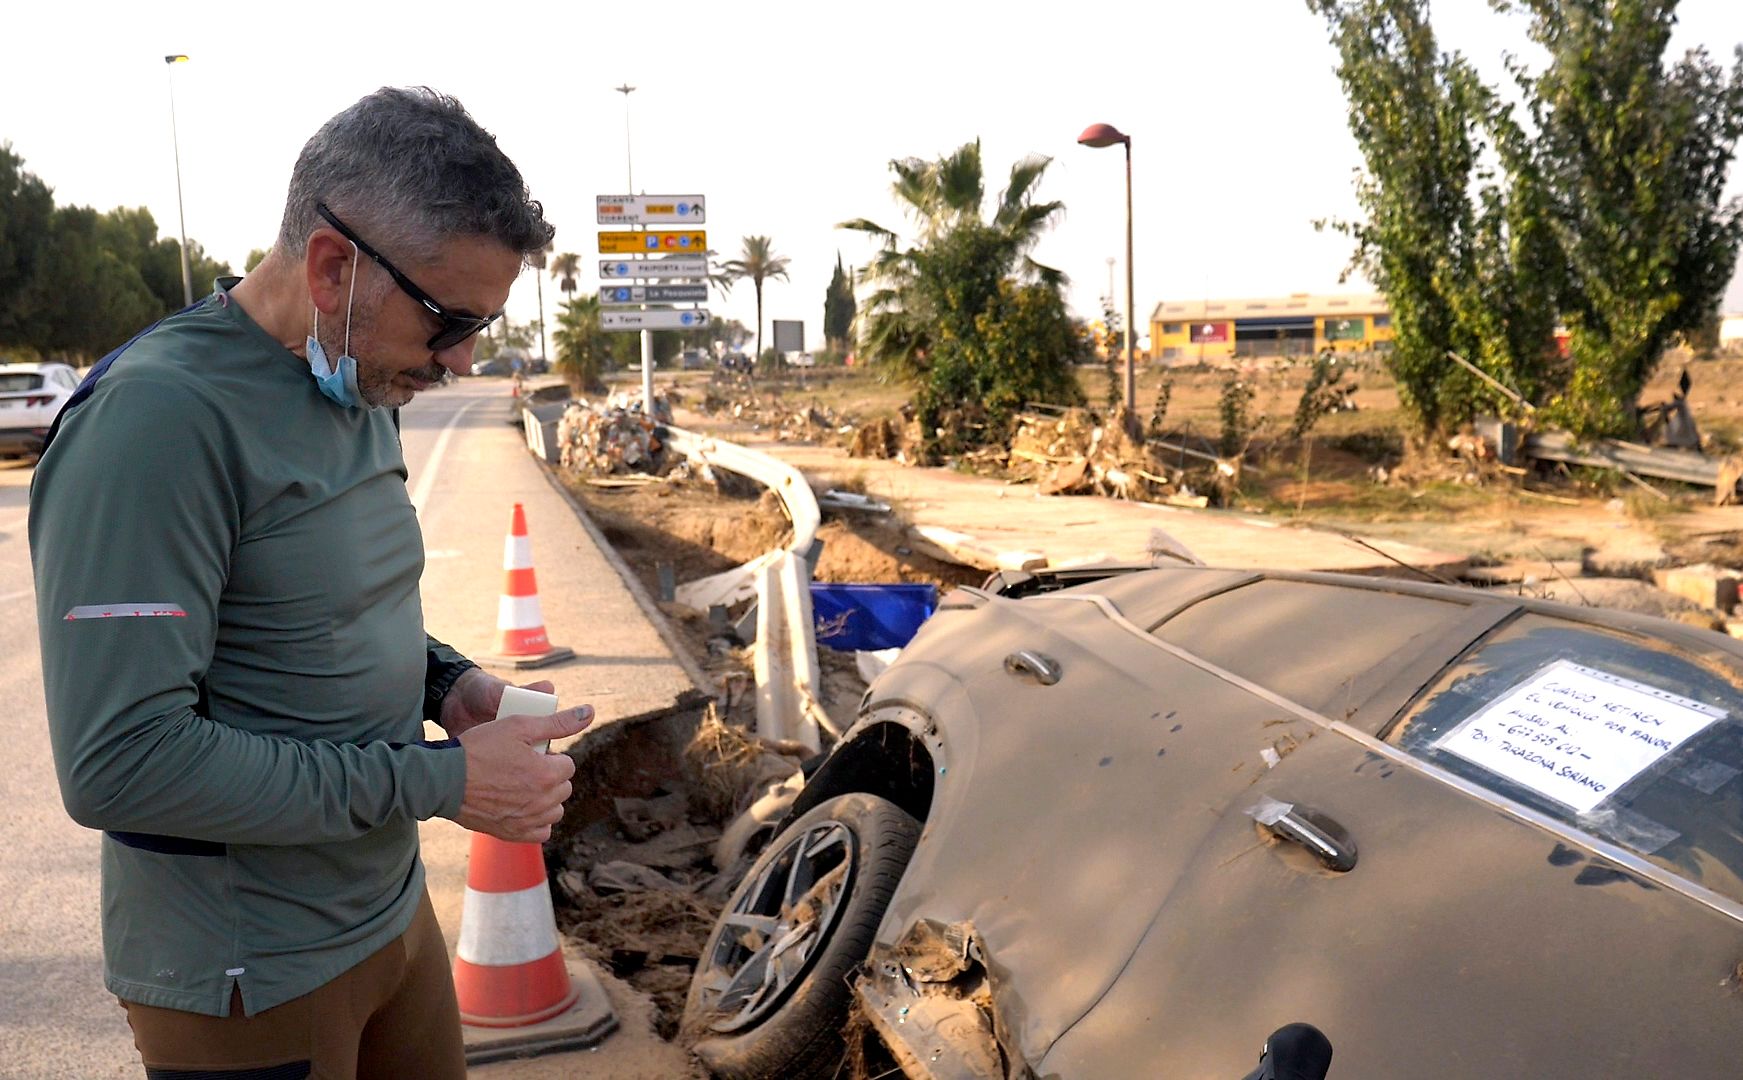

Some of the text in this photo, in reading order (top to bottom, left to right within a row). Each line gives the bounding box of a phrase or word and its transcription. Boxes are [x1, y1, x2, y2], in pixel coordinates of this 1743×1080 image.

[1525, 693, 1540, 703] EL
[1604, 721, 1627, 734] POR
[1630, 730, 1672, 751] FAVOR
[1543, 682, 1665, 726] CUANDO RETIREN
[1498, 740, 1556, 771] TARAZONA
[1556, 766, 1607, 792] SORIANO
